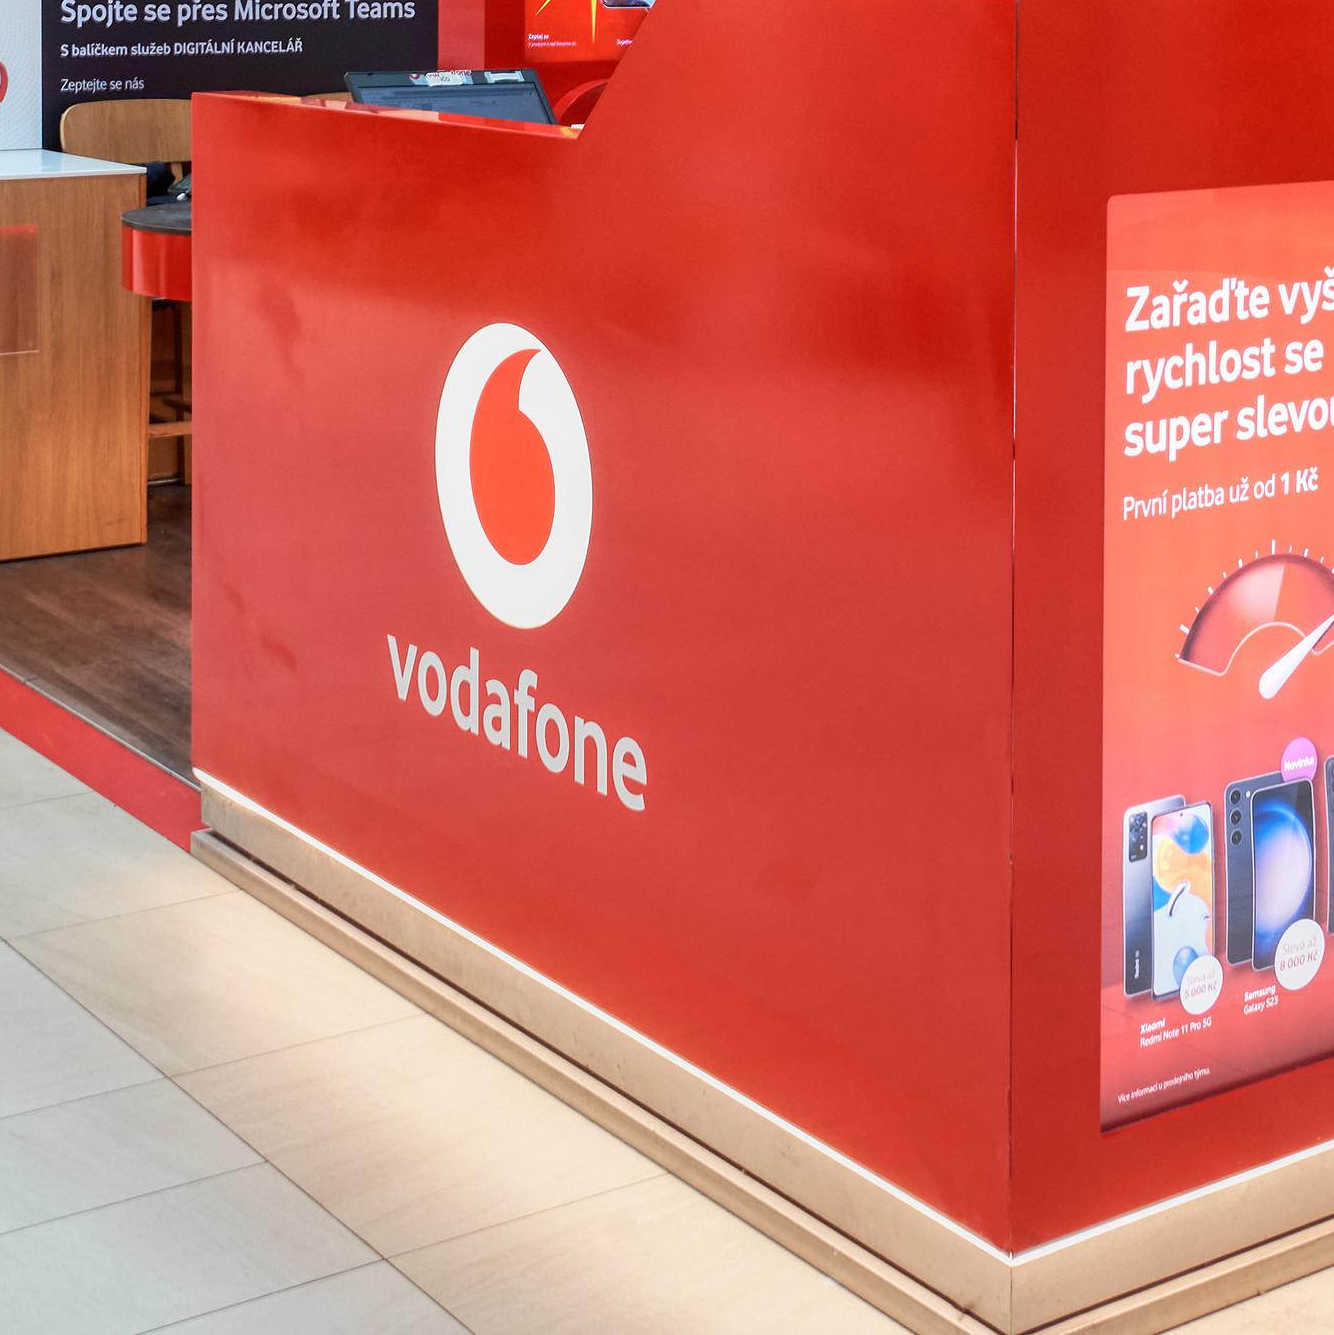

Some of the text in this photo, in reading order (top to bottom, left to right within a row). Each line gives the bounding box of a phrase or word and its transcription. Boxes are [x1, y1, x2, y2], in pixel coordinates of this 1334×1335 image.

[144, 4, 171, 22] se
[60, 37, 303, 57] S balíčkem služeb DIGITÁLNÍ KANCELÁŘ
[61, 77, 145, 93] Zeptejte se nás
[1124, 276, 1270, 333] Zařaďte
[1125, 336, 1324, 405] rychlost se
[1123, 409, 1229, 462] super
[1122, 466, 1319, 521] První platba už od 1 Kč
[386, 633, 649, 812] vodafone
[1284, 756, 1315, 772] Novinka
[1244, 985, 1276, 1002] Samsung
[1244, 1000, 1265, 1015] Galaxy
[1139, 1018, 1166, 1034] Xiaomi
[1139, 1017, 1212, 1048] Redmi Note 11 Pro 5G
[1117, 1092, 1131, 1103] Více
[1131, 1081, 1158, 1098] informací
[1163, 1072, 1194, 1090] prodejního
